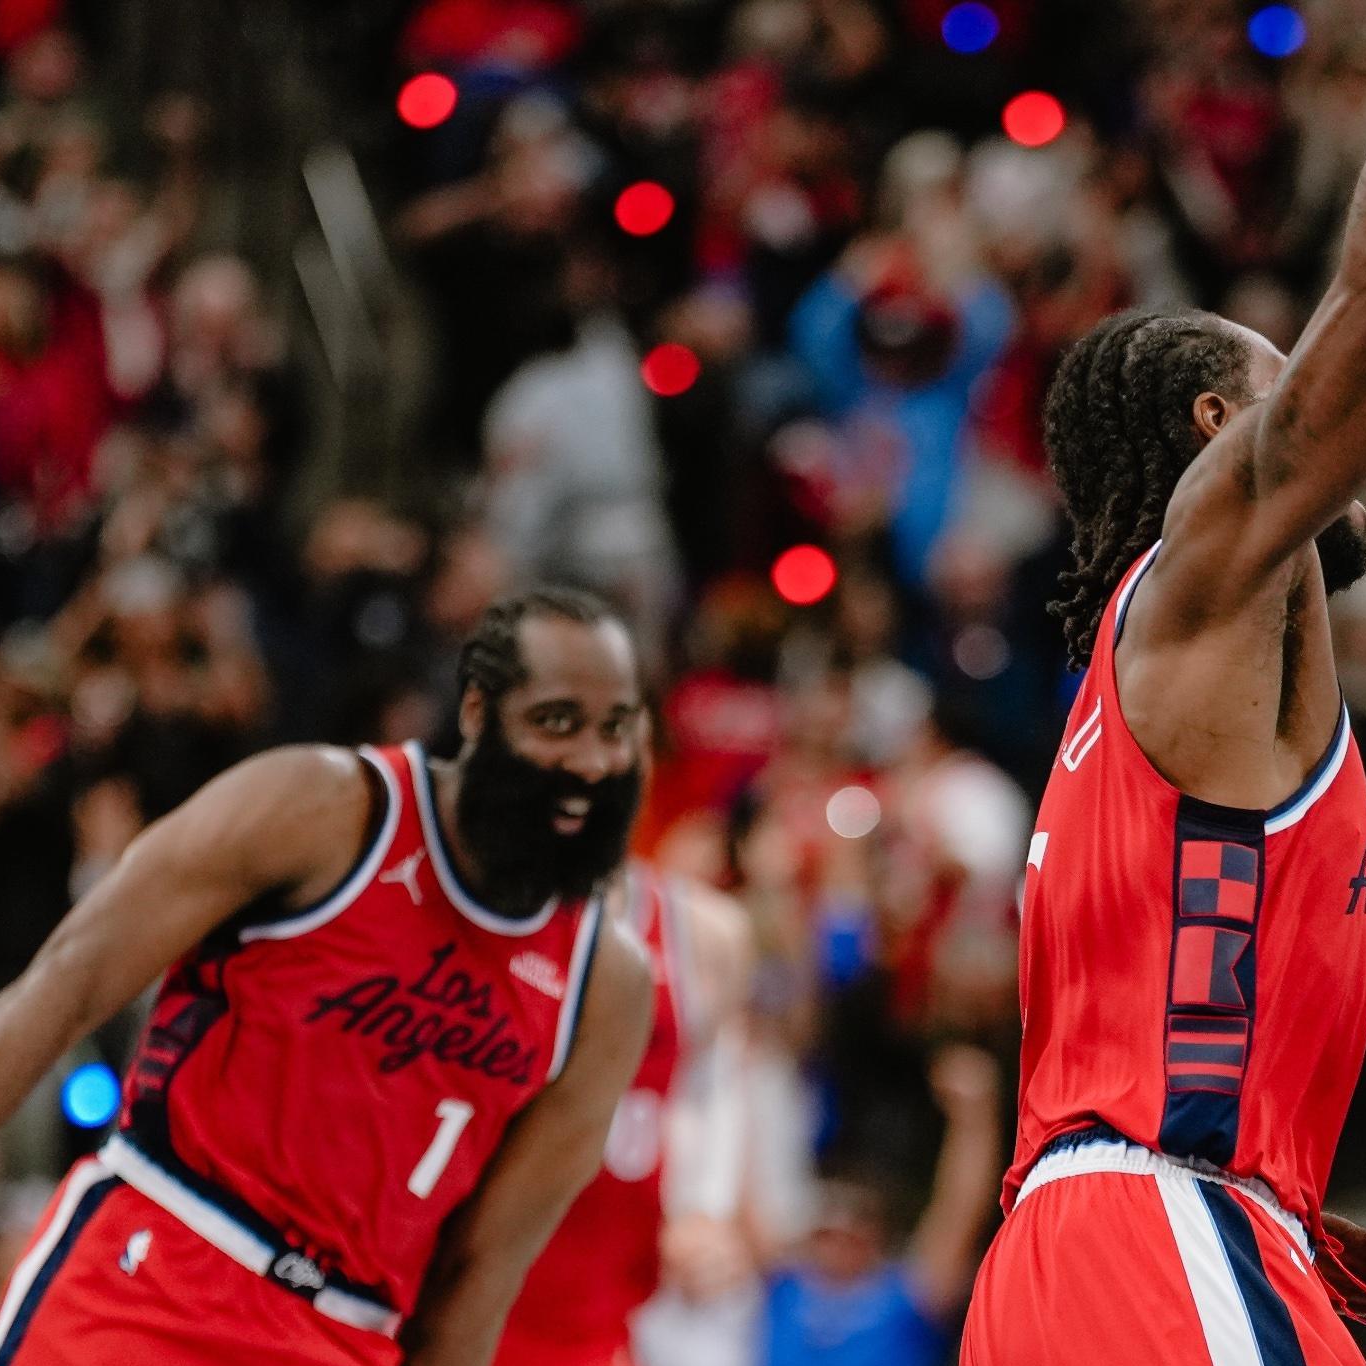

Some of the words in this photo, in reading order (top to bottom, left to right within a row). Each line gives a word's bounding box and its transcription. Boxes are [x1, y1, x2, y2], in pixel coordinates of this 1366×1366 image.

[305, 975, 538, 1084] Angeles
[409, 942, 492, 1018] Los
[407, 1098, 475, 1199] 1
